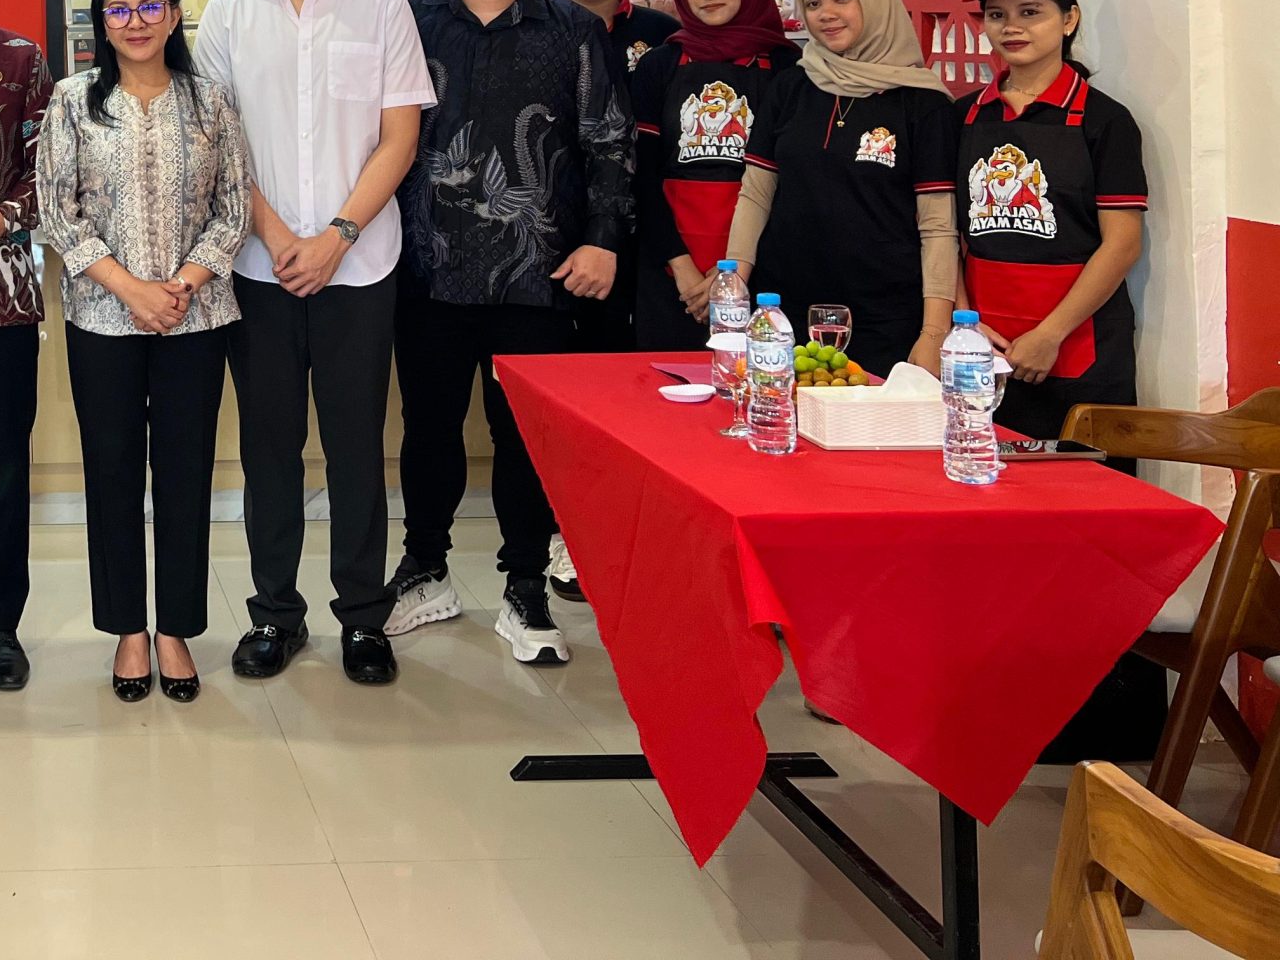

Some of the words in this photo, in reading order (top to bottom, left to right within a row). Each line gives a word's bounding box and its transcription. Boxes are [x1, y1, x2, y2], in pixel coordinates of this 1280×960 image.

[702, 135, 736, 147] RAJA
[681, 145, 718, 160] AYAM
[719, 146, 746, 158] ASA
[991, 205, 1029, 218] RAJA
[971, 217, 1011, 232] AYAM
[1013, 217, 1056, 235] ASAP
